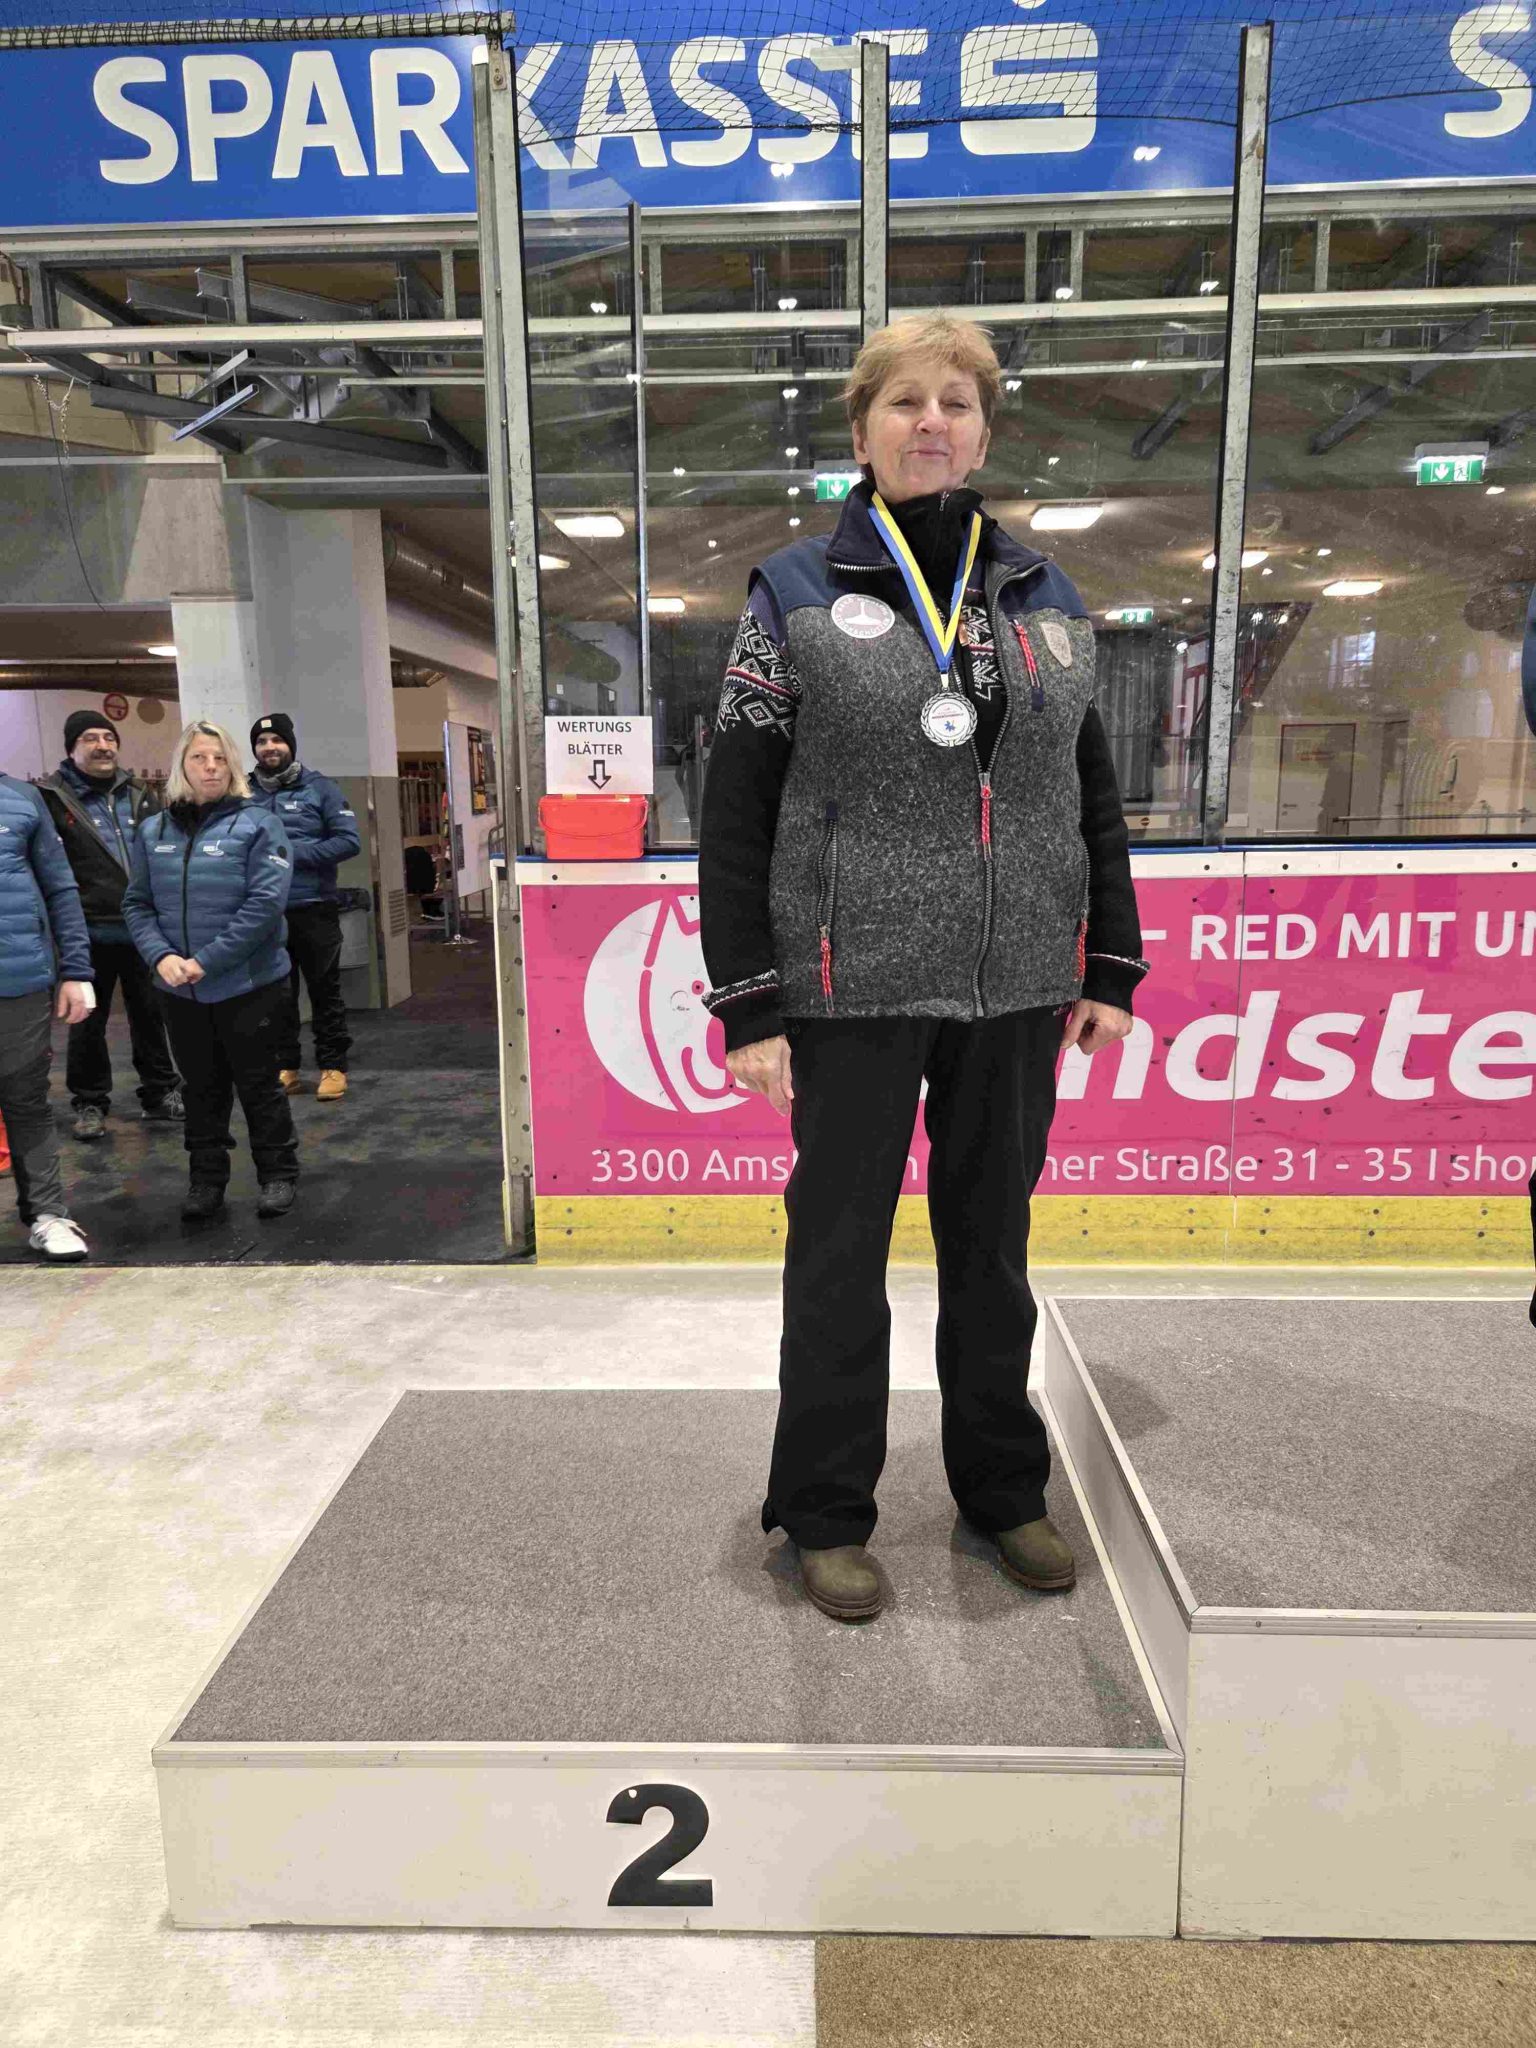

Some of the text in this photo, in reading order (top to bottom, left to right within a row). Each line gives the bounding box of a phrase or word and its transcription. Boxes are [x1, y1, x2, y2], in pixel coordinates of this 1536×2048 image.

[94, 29, 928, 184] SPARKASSE
[558, 721, 632, 733] WERTUNGS
[568, 741, 623, 755] BLÄTTER
[1190, 914, 1317, 961] RED
[1337, 912, 1457, 958] MIT
[591, 1149, 690, 1182] 3300
[1115, 1145, 1259, 1182] Straße
[1272, 1148, 1318, 1182] 31
[1362, 1148, 1413, 1182] 35
[606, 1783, 713, 1907] 2
